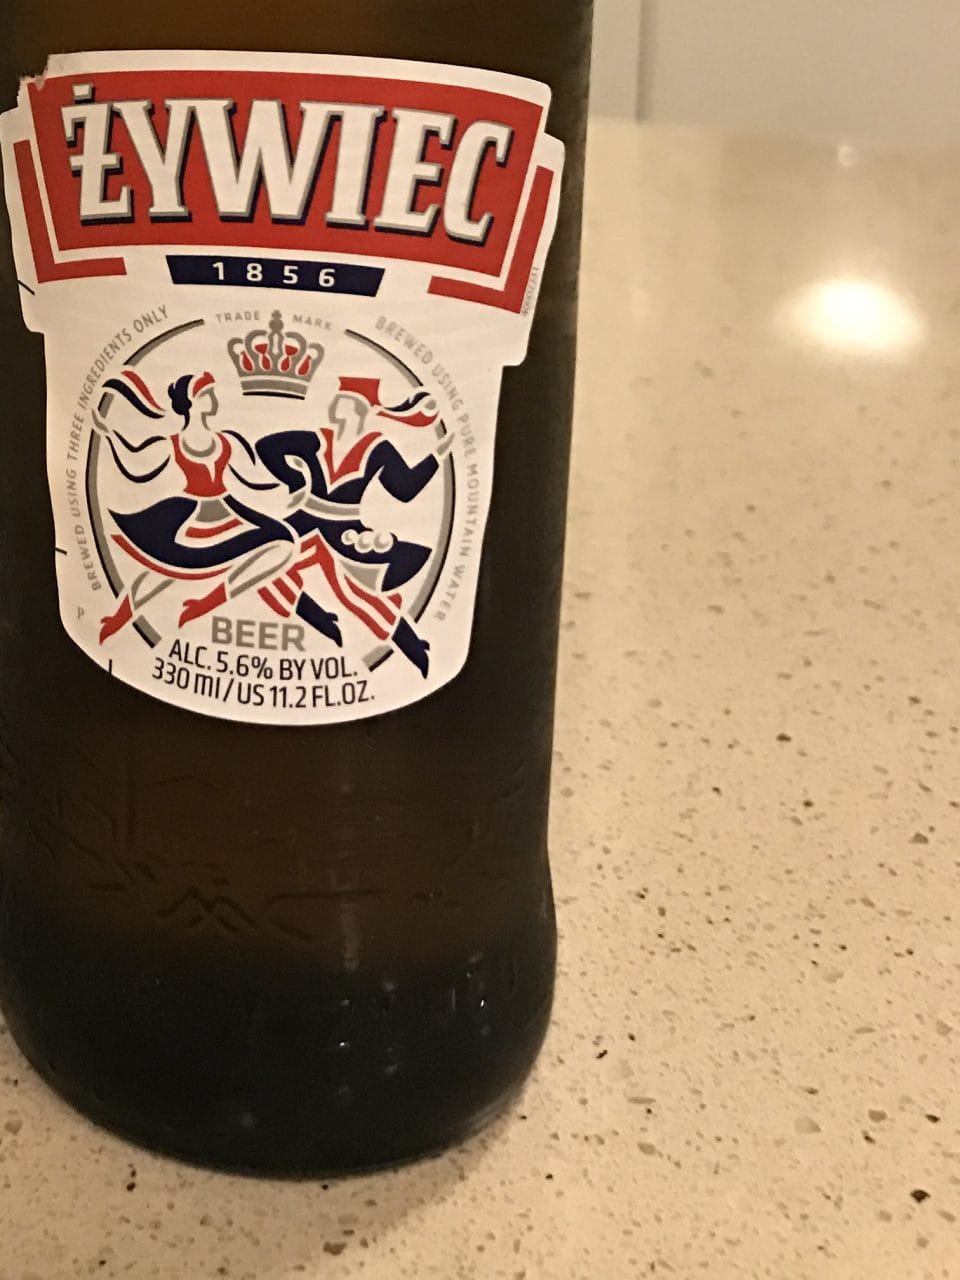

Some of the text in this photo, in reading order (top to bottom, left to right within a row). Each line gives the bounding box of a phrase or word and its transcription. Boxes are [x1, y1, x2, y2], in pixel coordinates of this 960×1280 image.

[60, 82, 514, 246] ŻYWIEC
[212, 261, 336, 288] 1856
[216, 310, 332, 330] TRADE MARK
[66, 304, 168, 591] BREWED USING THREE INGREDIENTS ONLY
[375, 315, 480, 621] BREWED USING PURE MOUNTAIN WATER
[211, 615, 306, 652] BEER
[151, 656, 190, 690] 330
[269, 685, 307, 708] 11.2
[168, 638, 358, 681] ALC. 5.6% BY VOL.
